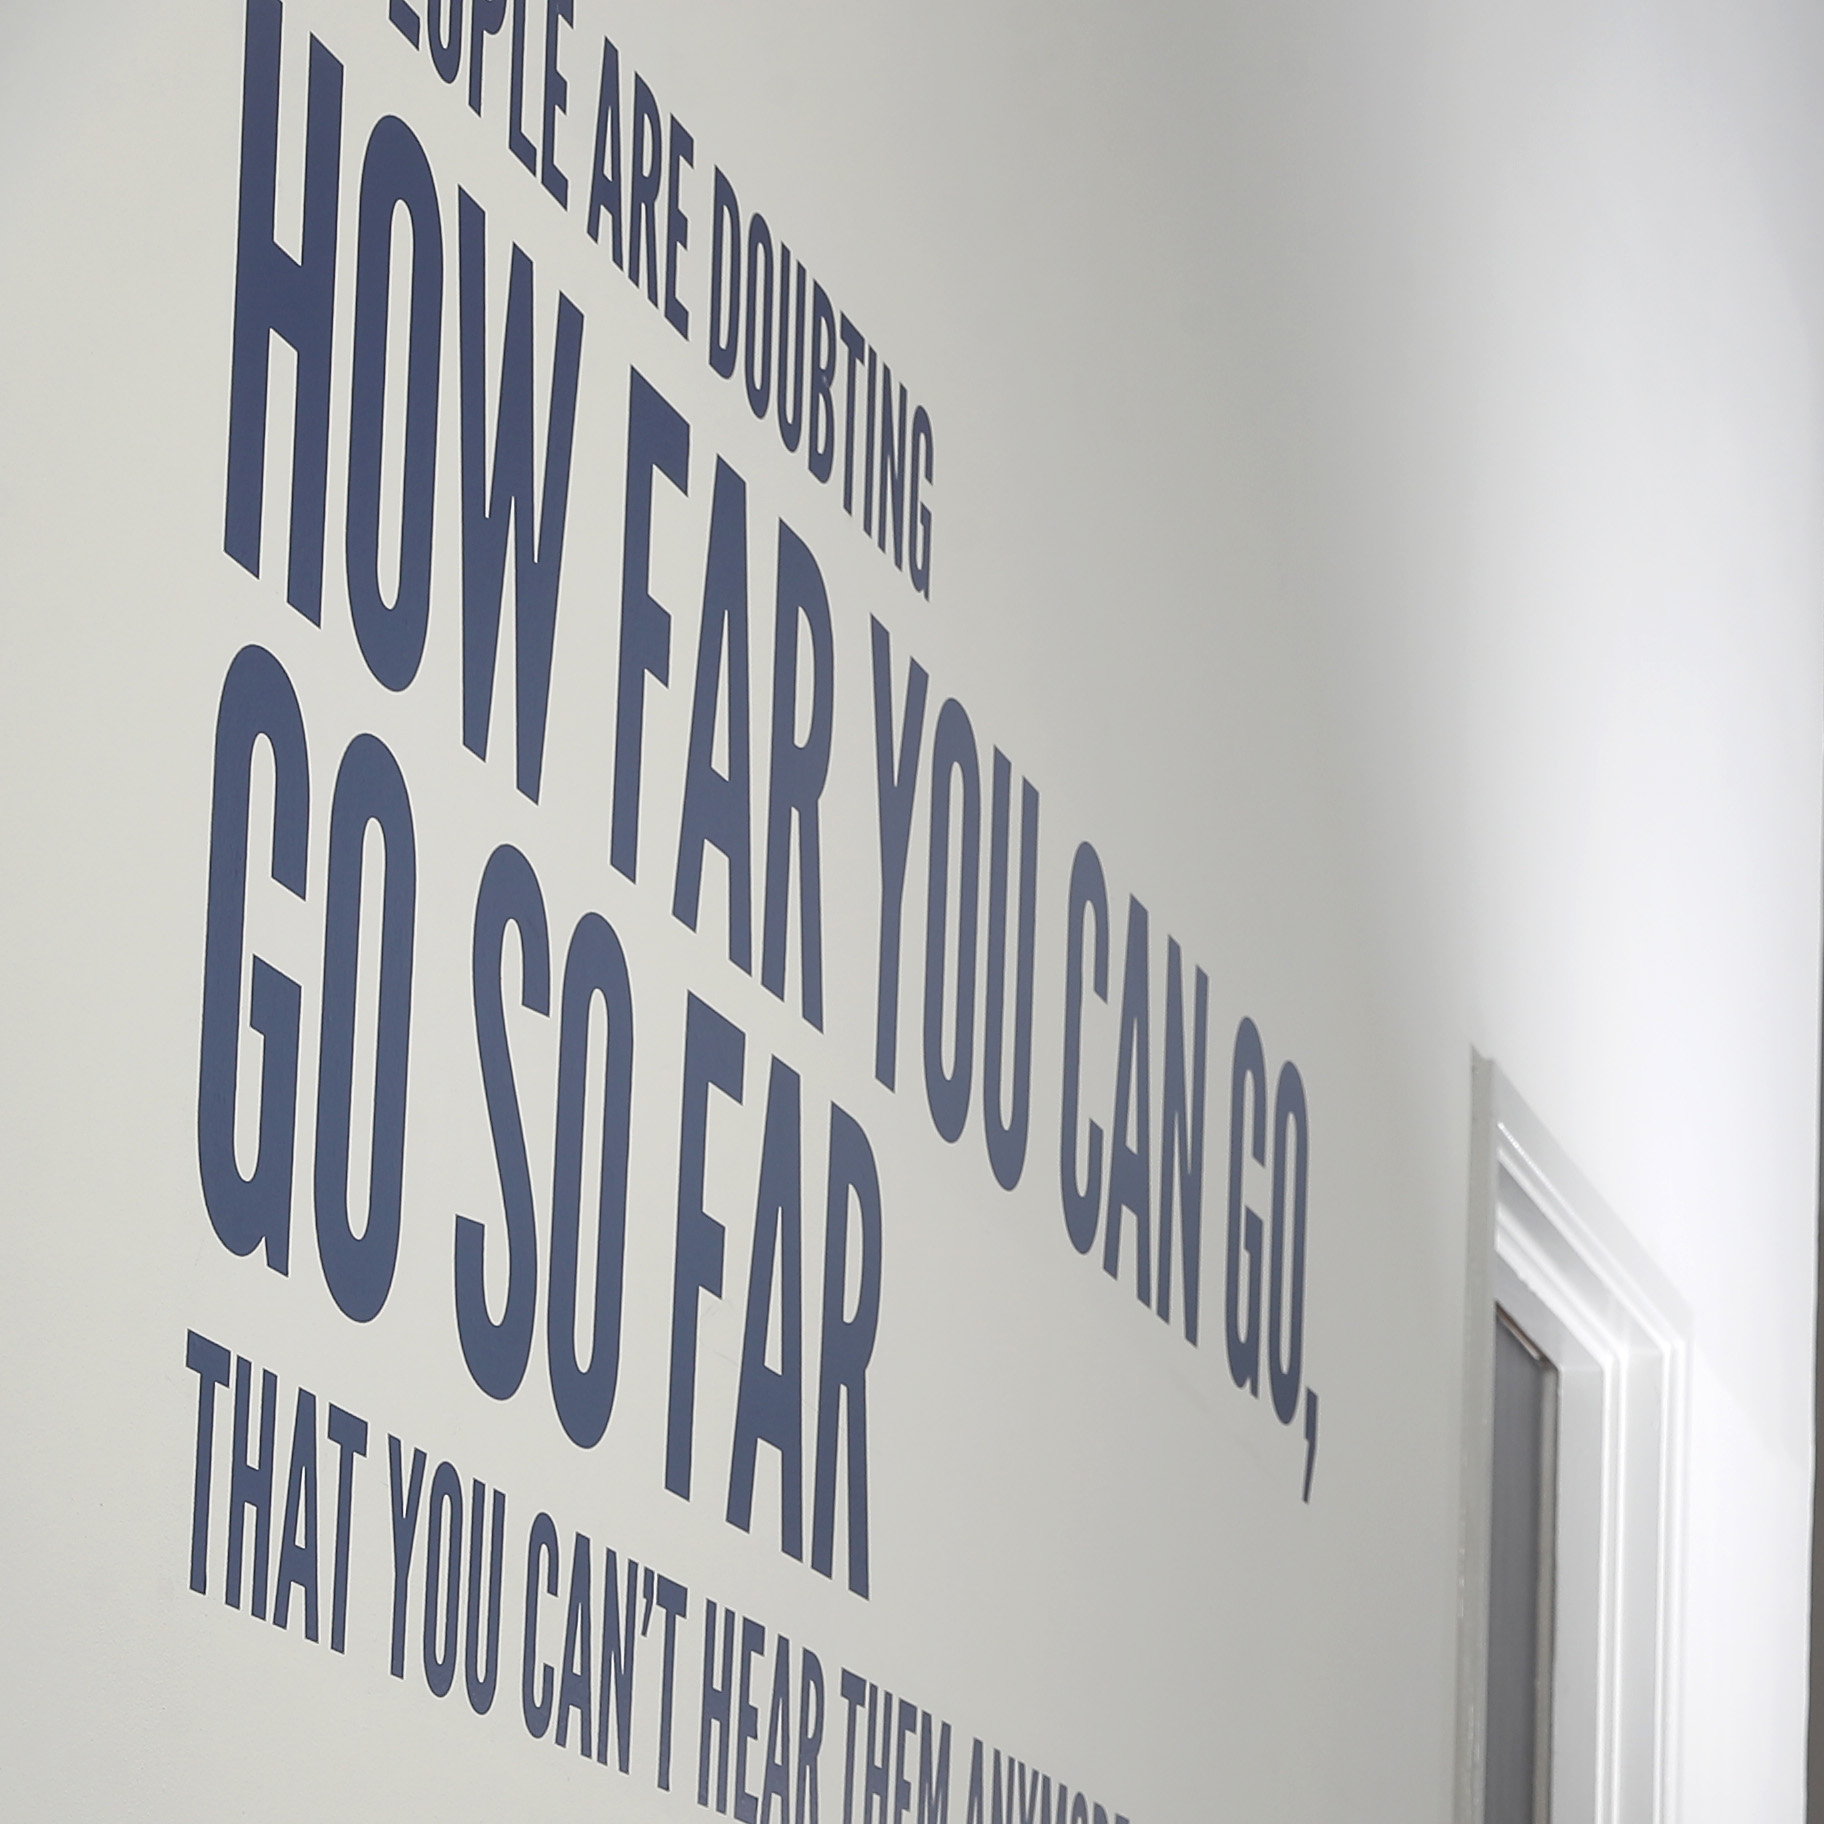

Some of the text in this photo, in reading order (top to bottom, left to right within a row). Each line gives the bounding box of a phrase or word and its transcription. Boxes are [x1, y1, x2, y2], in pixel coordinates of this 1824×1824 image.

[586, 35, 693, 341] ARE
[709, 166, 934, 602] DOUBTING
[198, 643, 882, 1600] GO SO FAR
[224, 0, 1319, 1503] HOW FAR YOU CAN GO,
[186, 1329, 369, 1655] THAT
[387, 1432, 506, 1716] YOU
[521, 1511, 688, 1792] CAN'T
